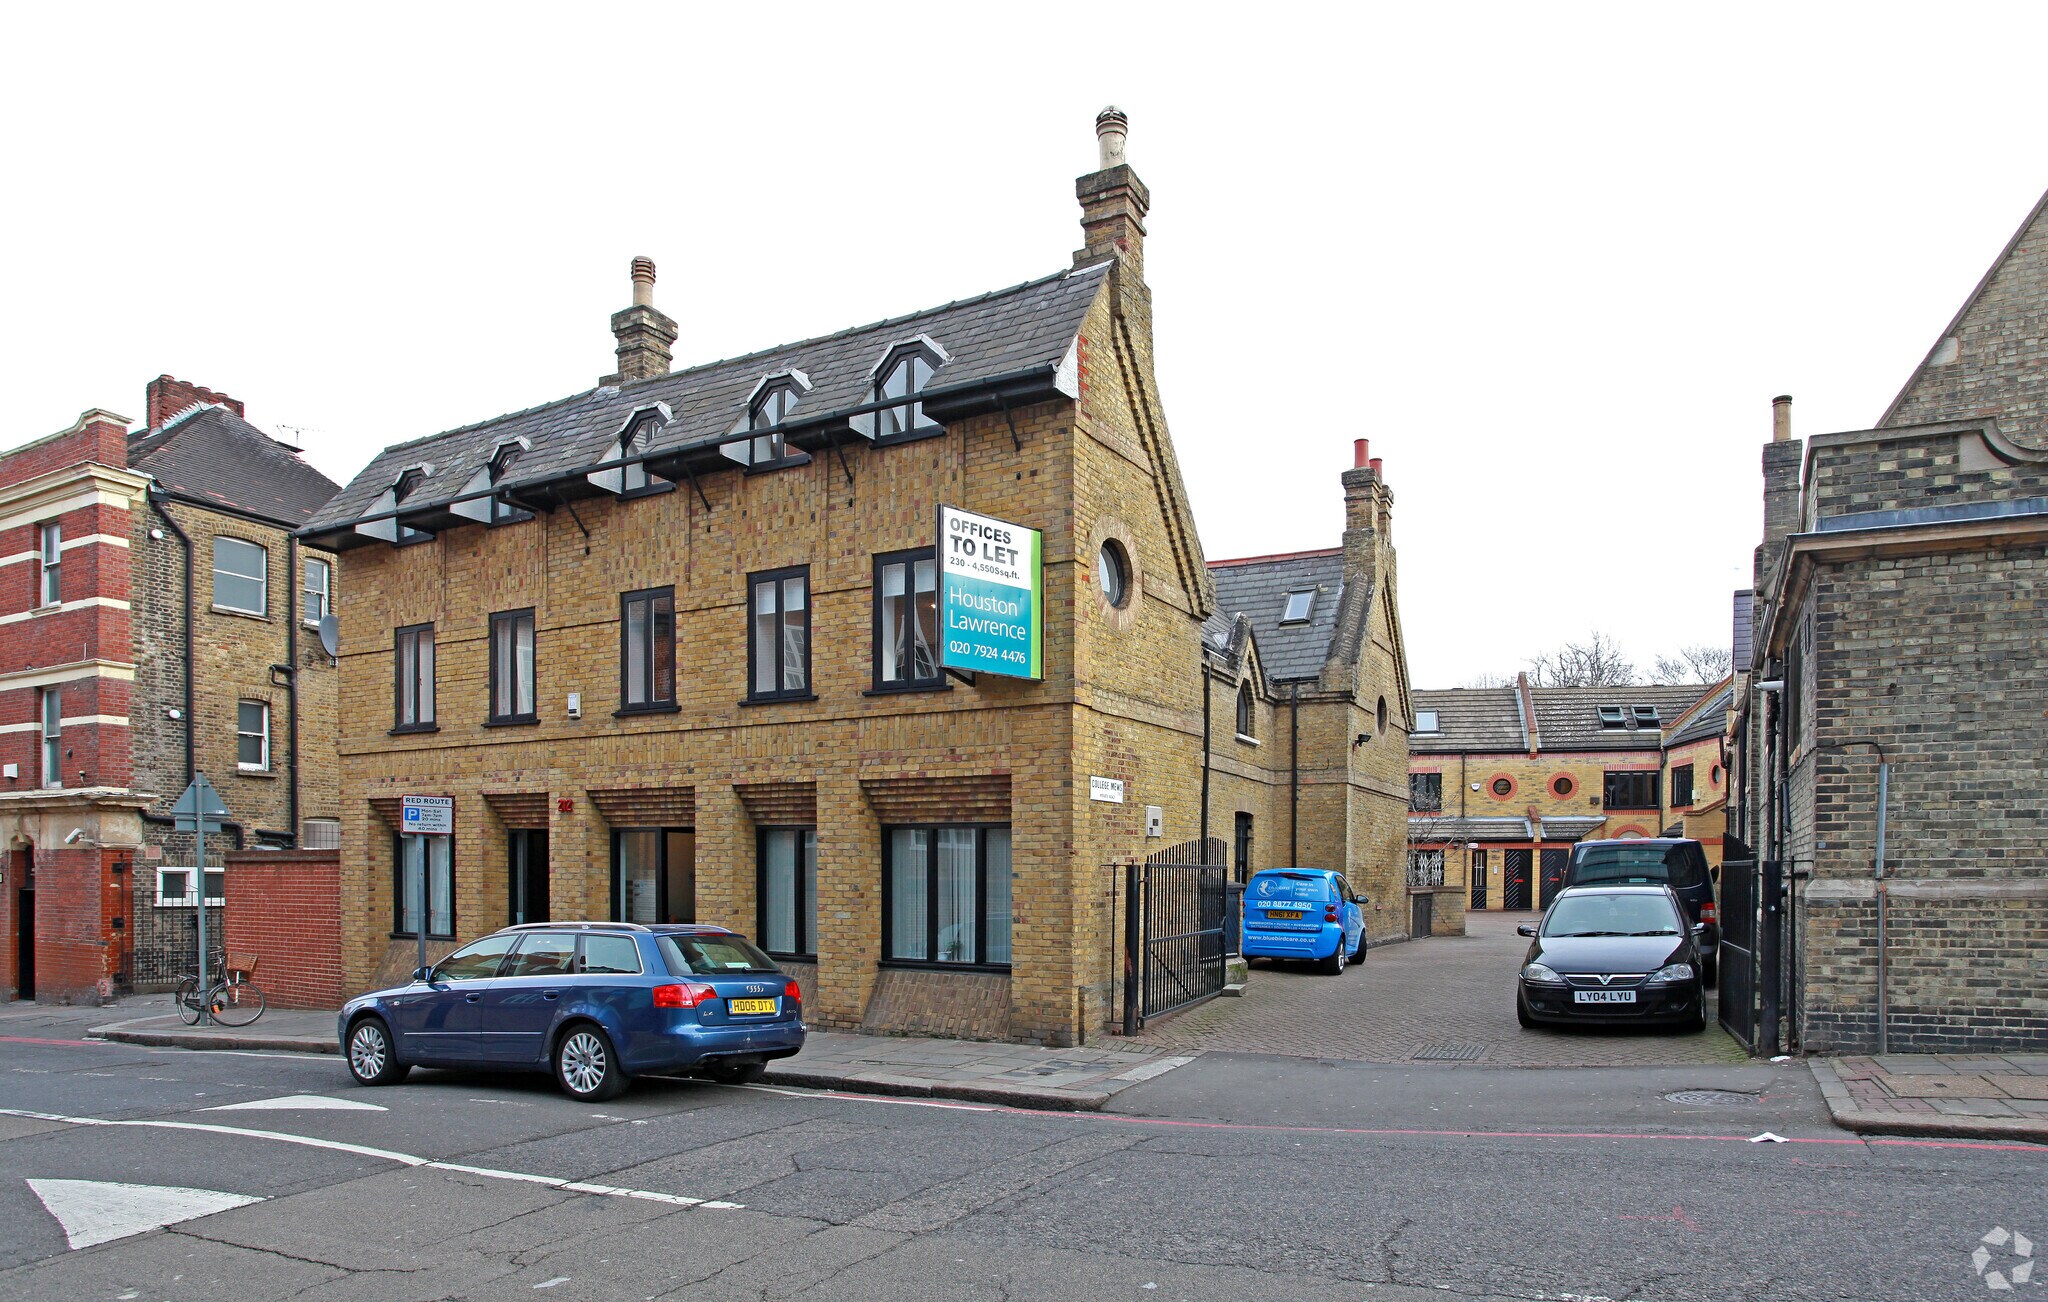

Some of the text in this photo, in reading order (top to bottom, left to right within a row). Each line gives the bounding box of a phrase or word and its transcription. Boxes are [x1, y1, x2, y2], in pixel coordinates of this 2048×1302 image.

[950, 517, 1012, 545] OFFICES
[950, 534, 1019, 567] TO LET
[950, 556, 966, 567] 230
[950, 586, 1018, 617] Houston
[950, 609, 1026, 641] Lawrence
[949, 640, 1026, 664] 020 7924 4476
[1092, 780, 1122, 791] COLLEGE MEWS
[408, 809, 418, 820] P
[1580, 992, 1631, 1001] LY04 LYU
[734, 1001, 775, 1011] HD06 DTX
